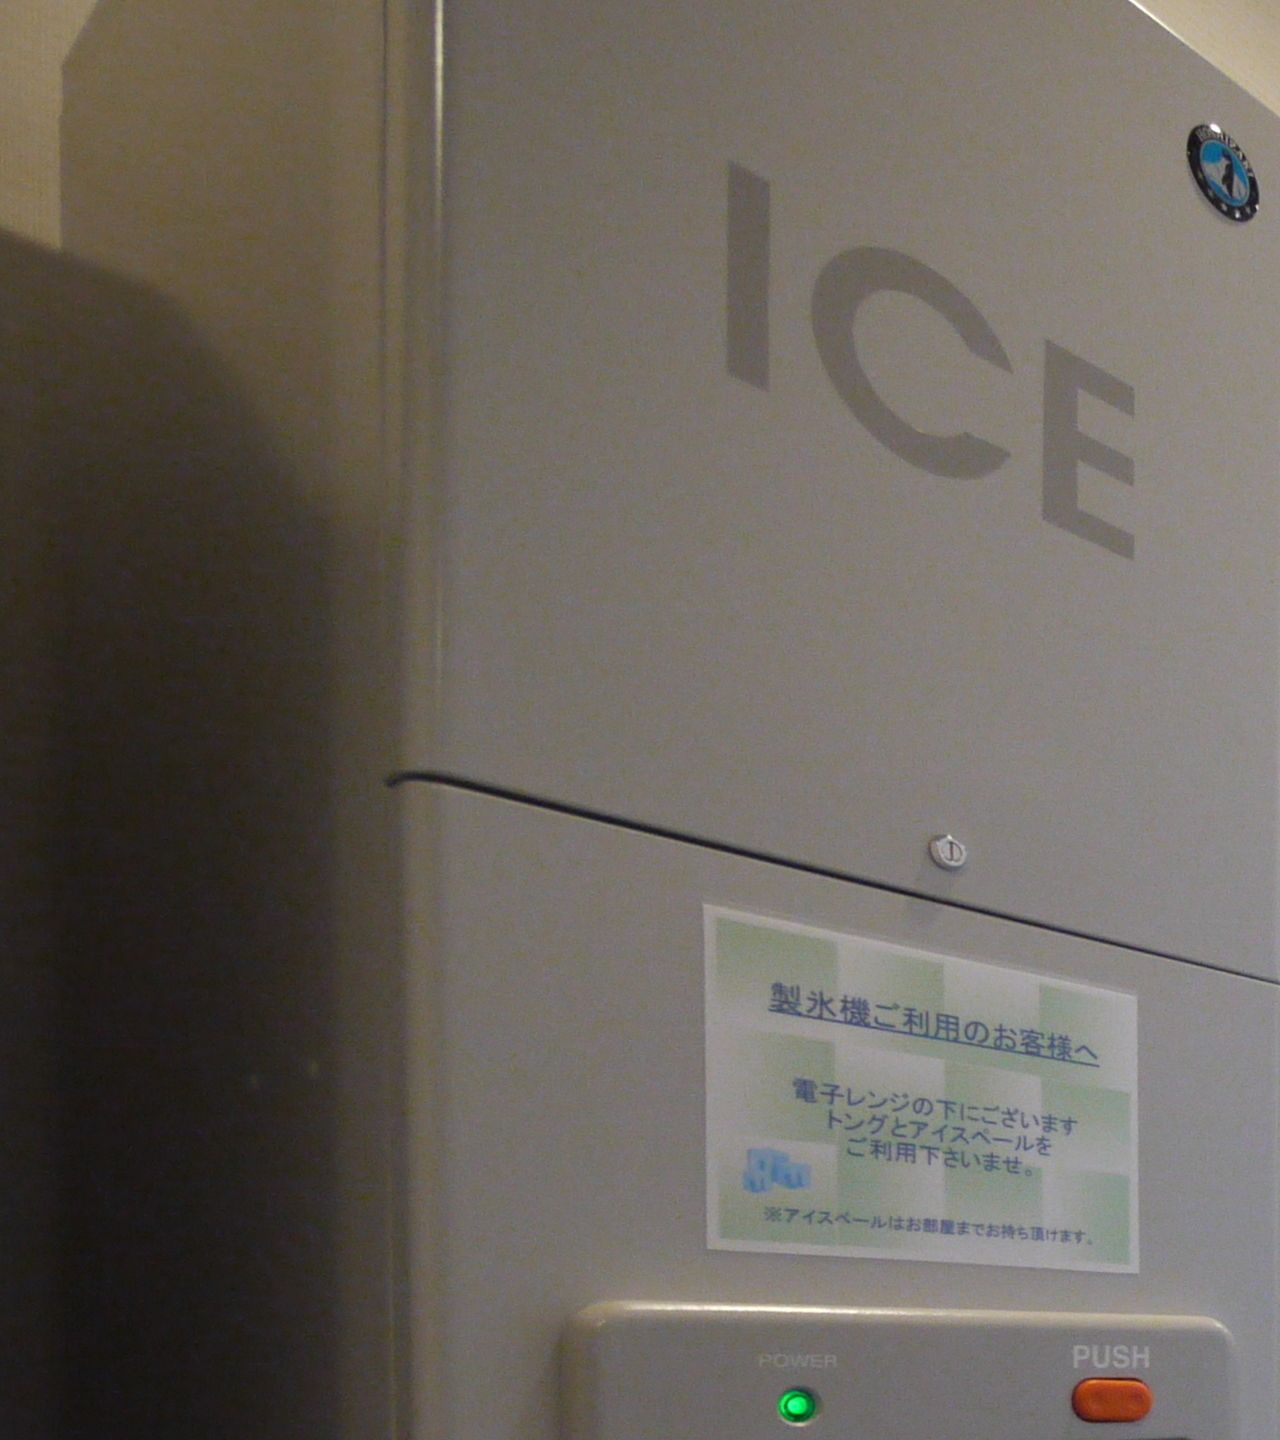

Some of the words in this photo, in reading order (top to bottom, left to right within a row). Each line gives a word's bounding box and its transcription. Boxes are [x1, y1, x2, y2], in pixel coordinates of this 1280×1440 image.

[727, 161, 1136, 560] ICE
[769, 982, 1100, 1064] 製氷機ご利用のお客様へ
[793, 1077, 1078, 1136] 電子レンジの下にございます
[826, 1112, 1053, 1157] トングとアイスペールを
[847, 1136, 1034, 1178] ご利用下さいませ。
[758, 1353, 838, 1369] POWER
[1072, 1345, 1150, 1369] PUSH
